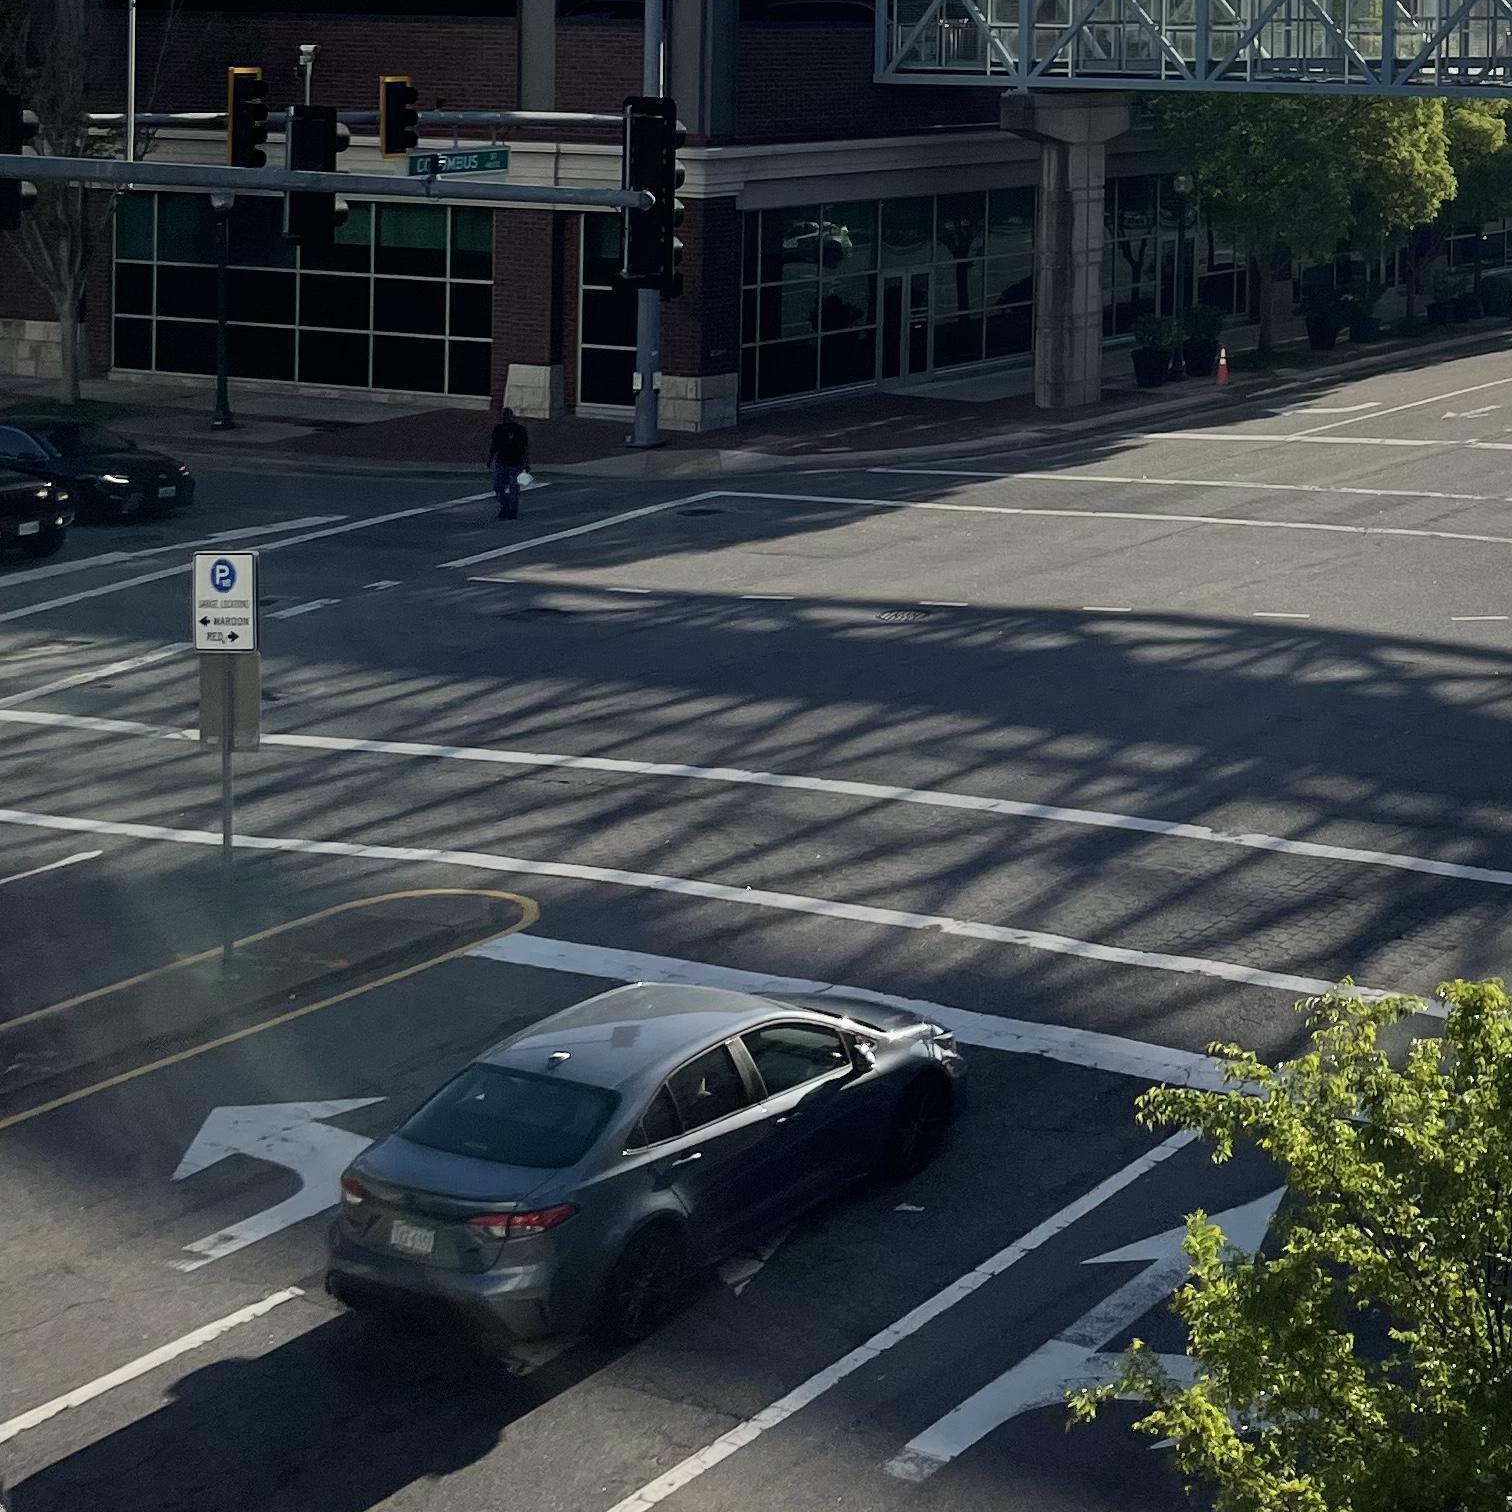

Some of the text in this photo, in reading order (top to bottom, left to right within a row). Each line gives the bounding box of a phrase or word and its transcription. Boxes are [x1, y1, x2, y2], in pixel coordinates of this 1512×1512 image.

[417, 155, 478, 173] COMBUS
[213, 617, 250, 626] MAROON
[207, 631, 223, 641] RED
